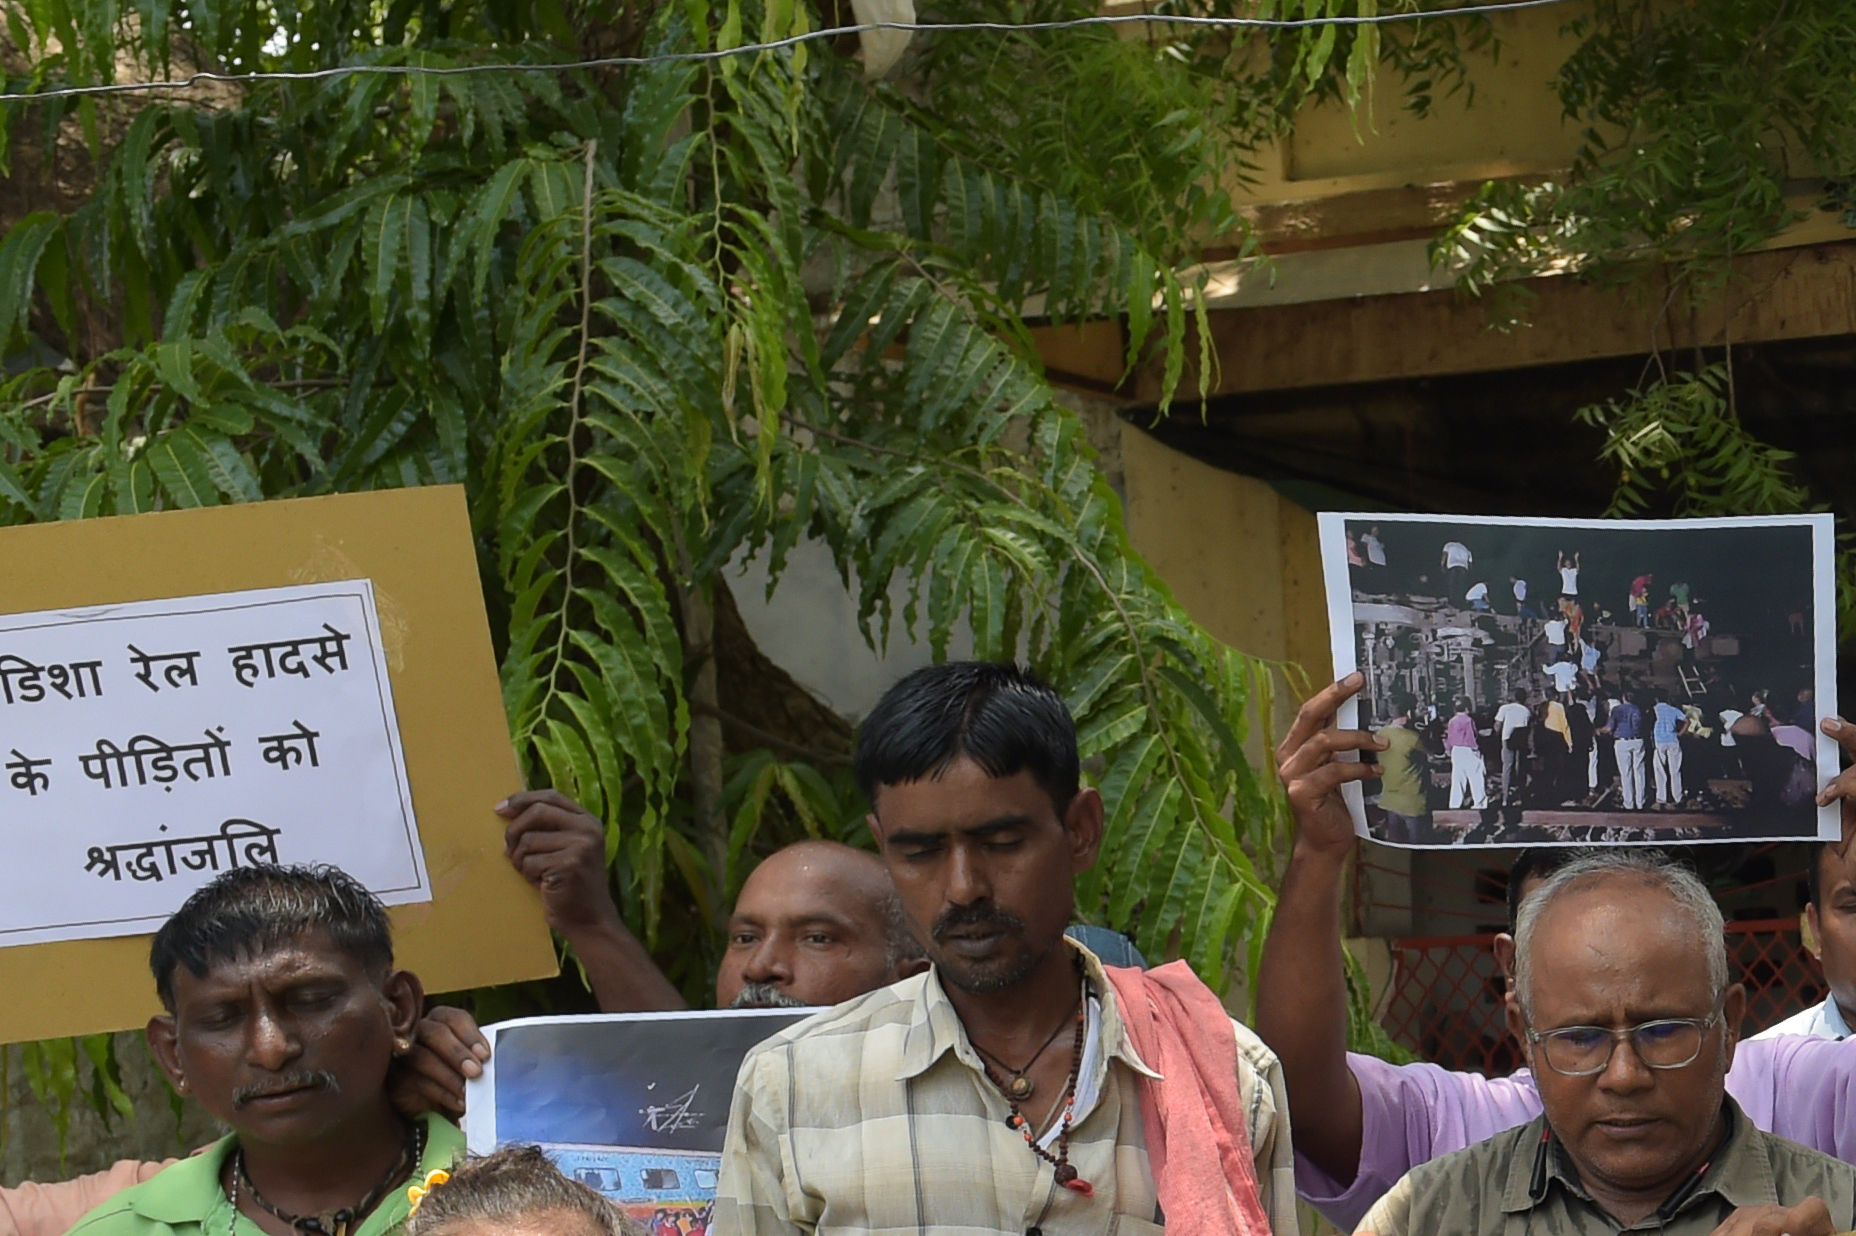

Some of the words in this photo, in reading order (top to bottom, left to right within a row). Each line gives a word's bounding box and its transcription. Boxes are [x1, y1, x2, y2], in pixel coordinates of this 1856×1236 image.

[0, 654, 103, 705] डिशा
[127, 643, 202, 693] रेल
[227, 623, 351, 688] हादसे
[5, 748, 53, 796] के
[78, 725, 232, 793] पीड़ितों
[257, 719, 320, 771] को
[82, 817, 283, 883] श्रद्धांजलि
